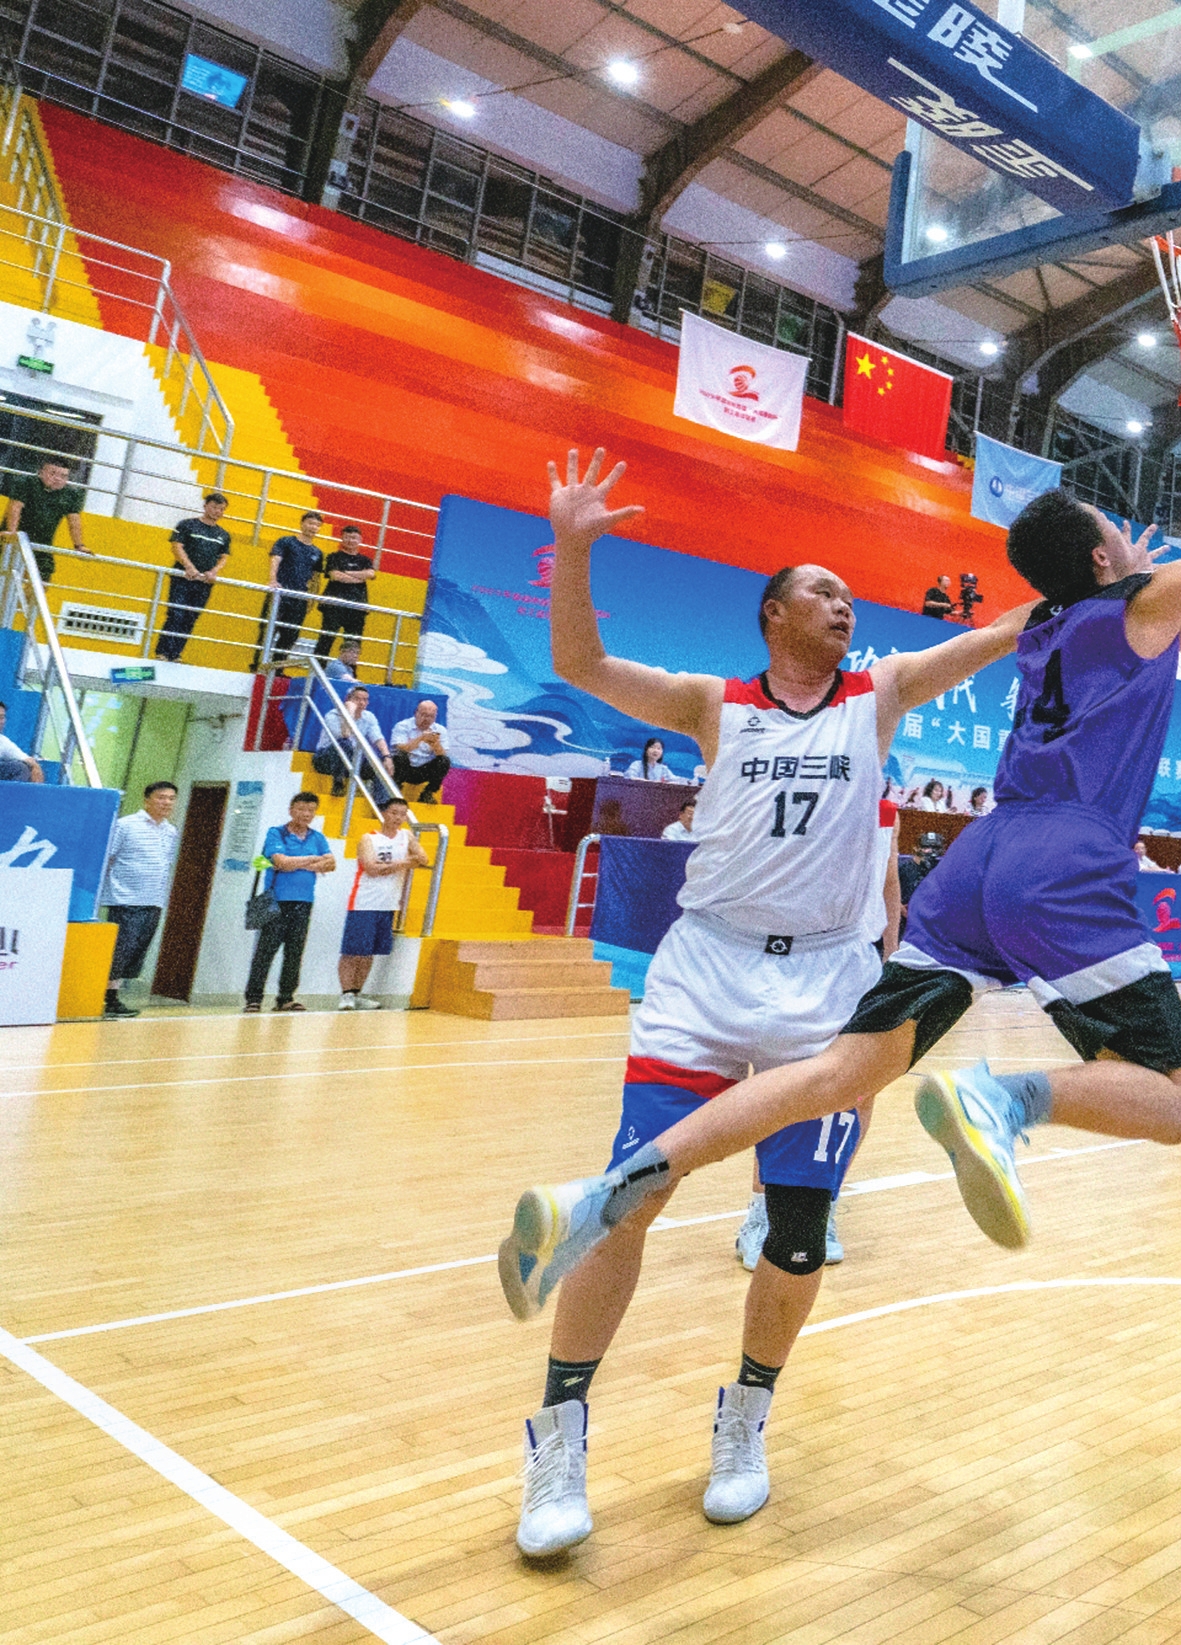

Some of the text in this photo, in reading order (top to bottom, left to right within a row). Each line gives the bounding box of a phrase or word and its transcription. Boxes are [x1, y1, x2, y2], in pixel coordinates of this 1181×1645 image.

[741, 755, 850, 783] 中国三峡
[771, 791, 819, 837] 17
[813, 1111, 856, 1164] 17
